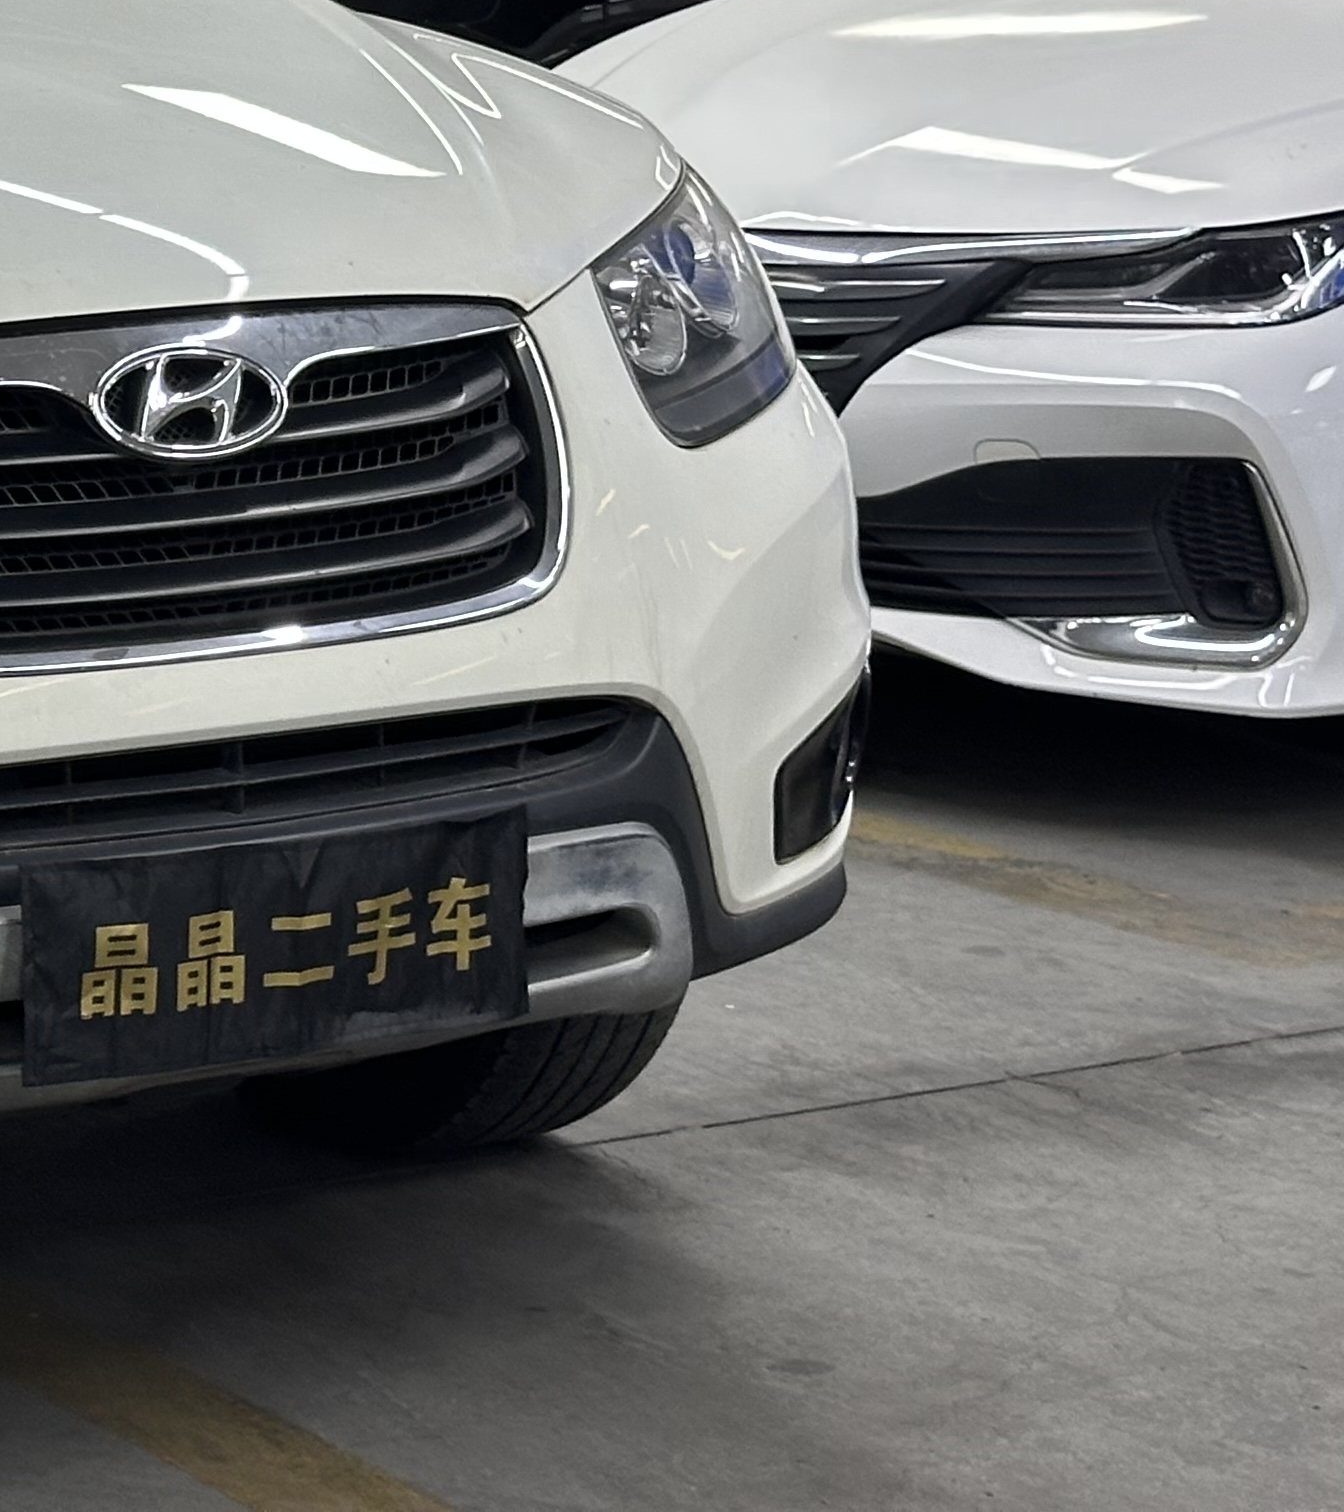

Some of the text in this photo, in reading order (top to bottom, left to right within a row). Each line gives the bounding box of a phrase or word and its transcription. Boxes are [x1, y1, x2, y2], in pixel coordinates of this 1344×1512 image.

[80, 877, 492, 1021] 晶晶二手车
